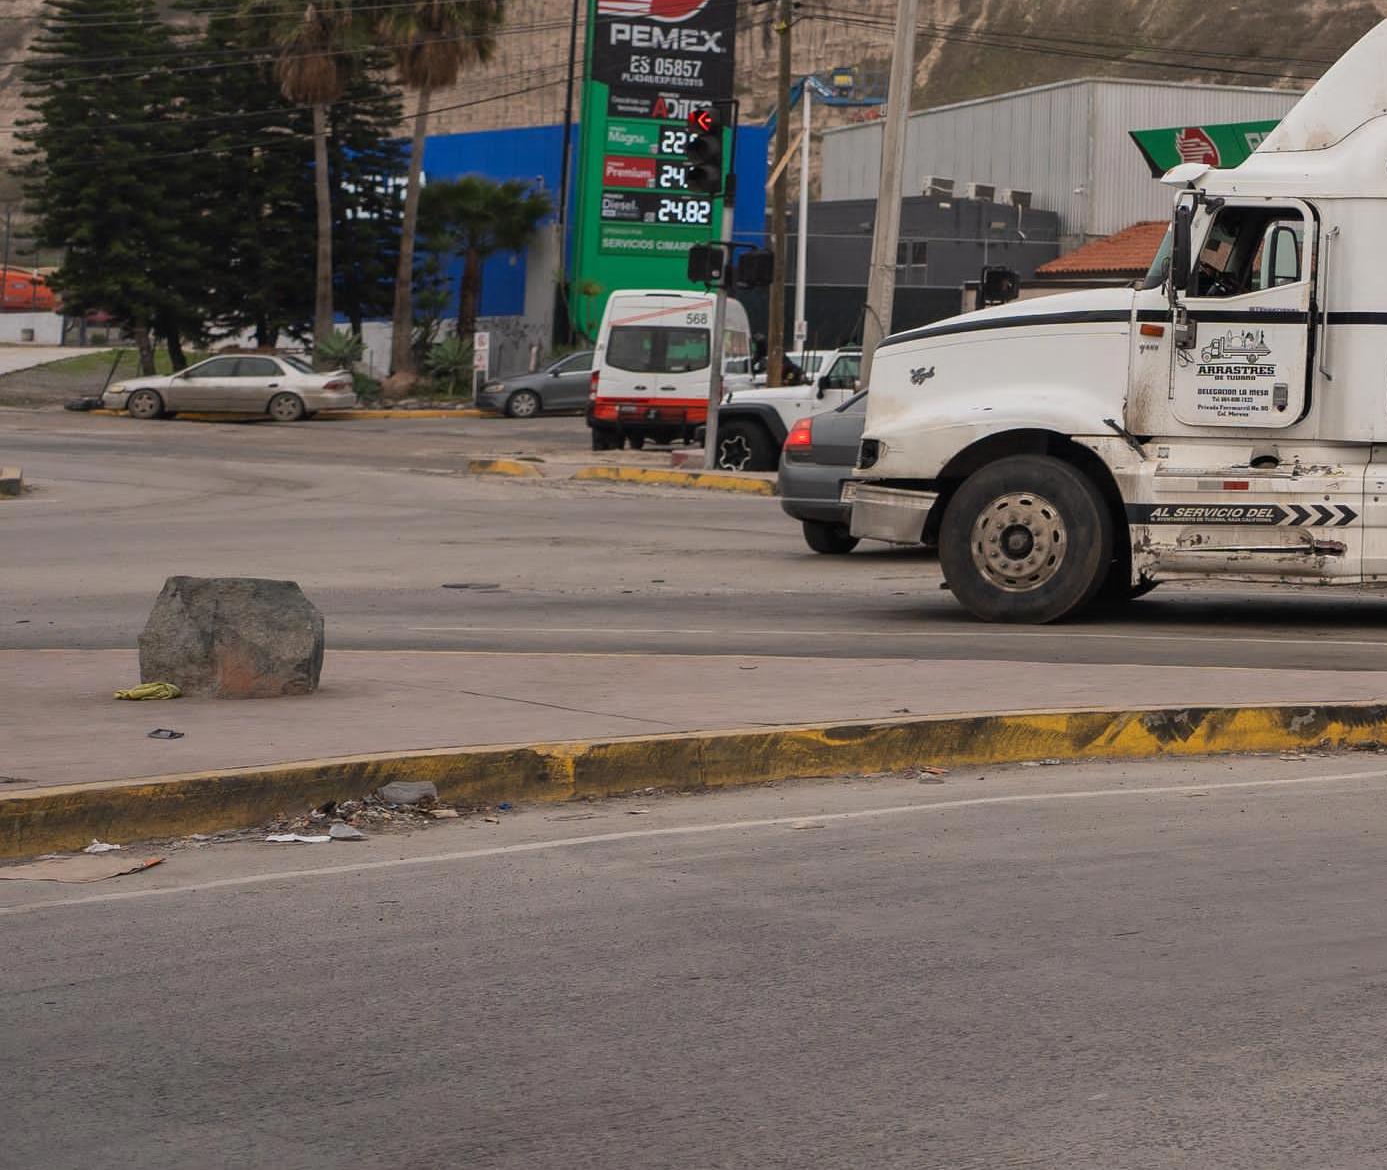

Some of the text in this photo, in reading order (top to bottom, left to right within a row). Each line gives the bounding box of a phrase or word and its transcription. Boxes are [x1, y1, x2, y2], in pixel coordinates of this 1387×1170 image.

[610, 23, 723, 52] PEMEX
[630, 55, 703, 78] ES 05857
[658, 199, 711, 223] 24.82
[686, 313, 708, 325] 568
[1198, 365, 1275, 375] ARRASTRES
[1150, 508, 1275, 518] AL SERVICIO DEL
